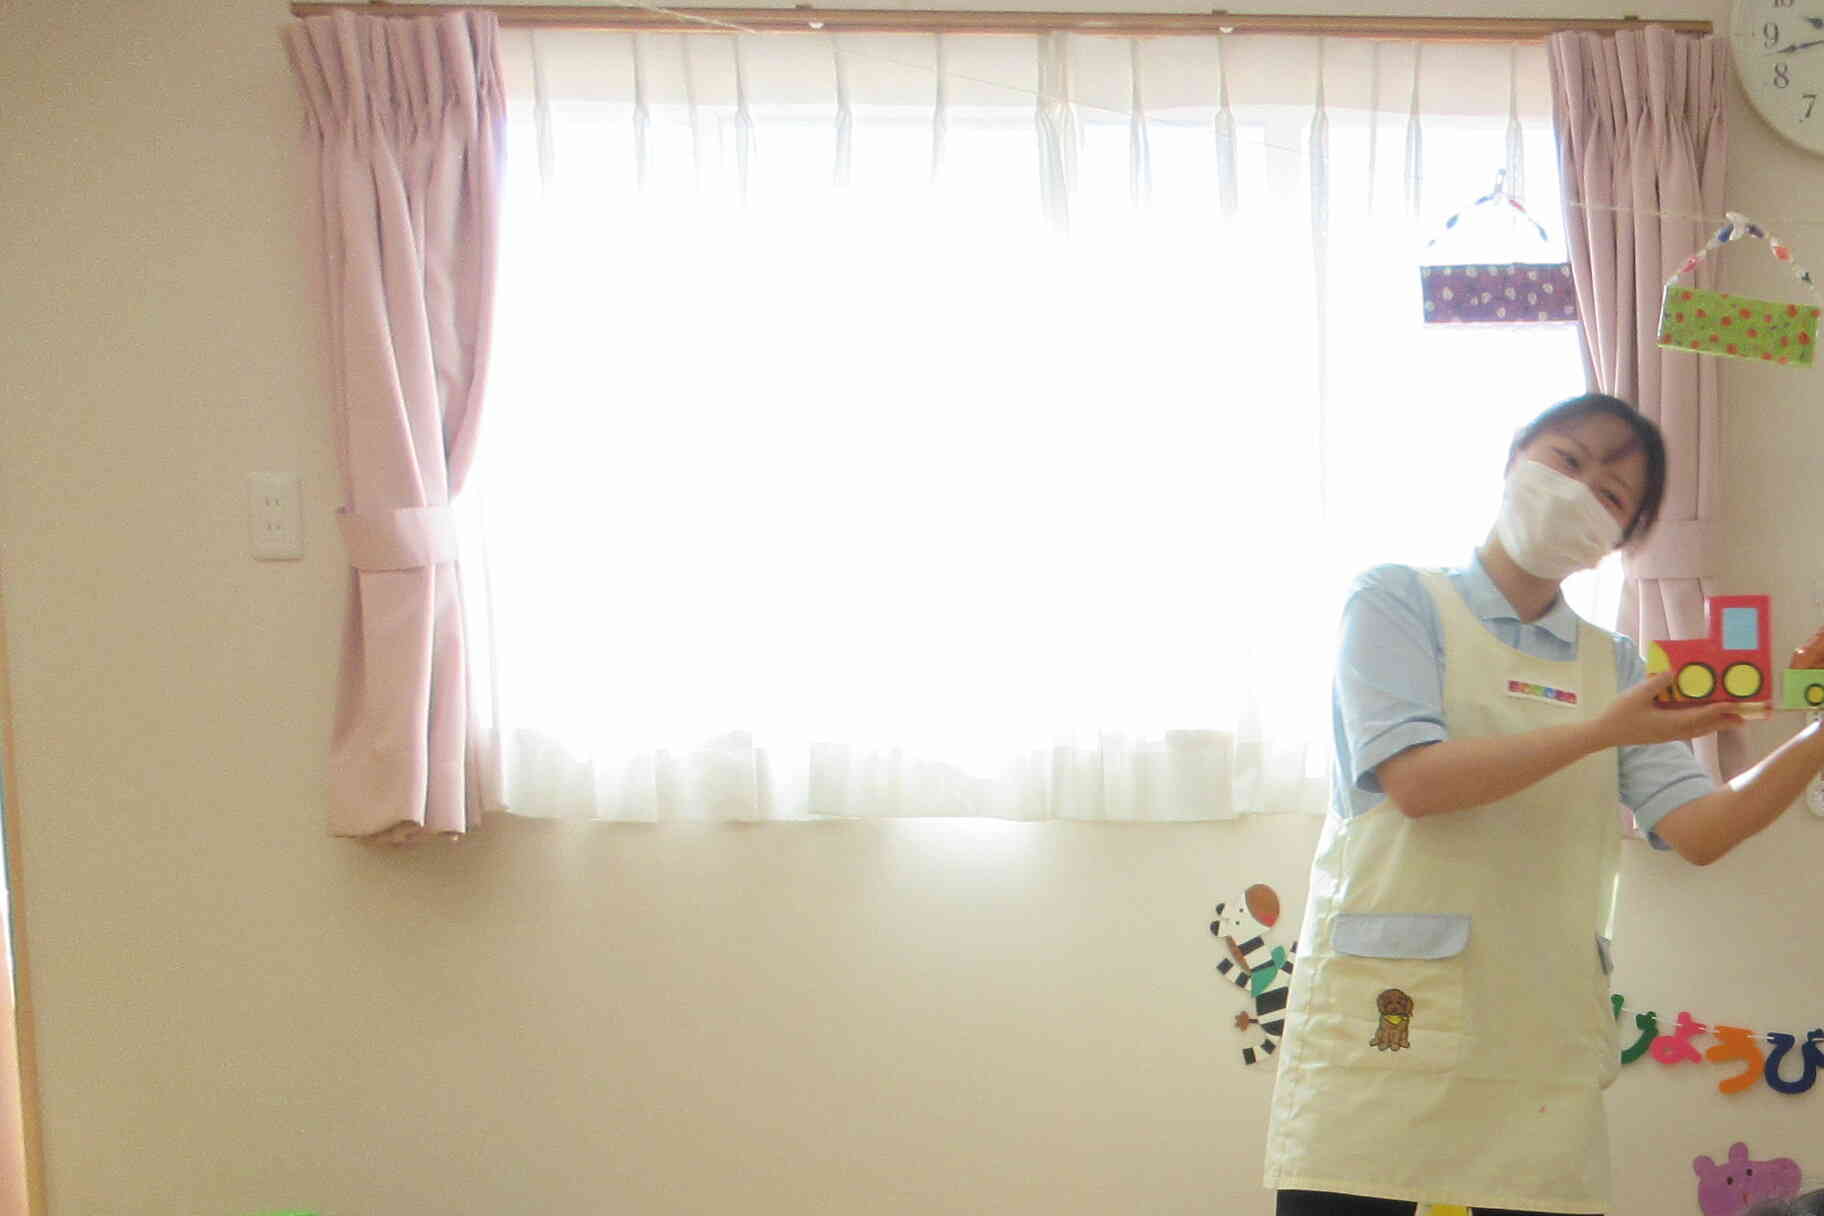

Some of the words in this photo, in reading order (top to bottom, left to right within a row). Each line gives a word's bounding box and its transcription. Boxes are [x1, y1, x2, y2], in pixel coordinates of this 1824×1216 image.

[1763, 22, 1779, 49] 9
[1773, 63, 1790, 89] 8
[1801, 94, 1817, 120] 7
